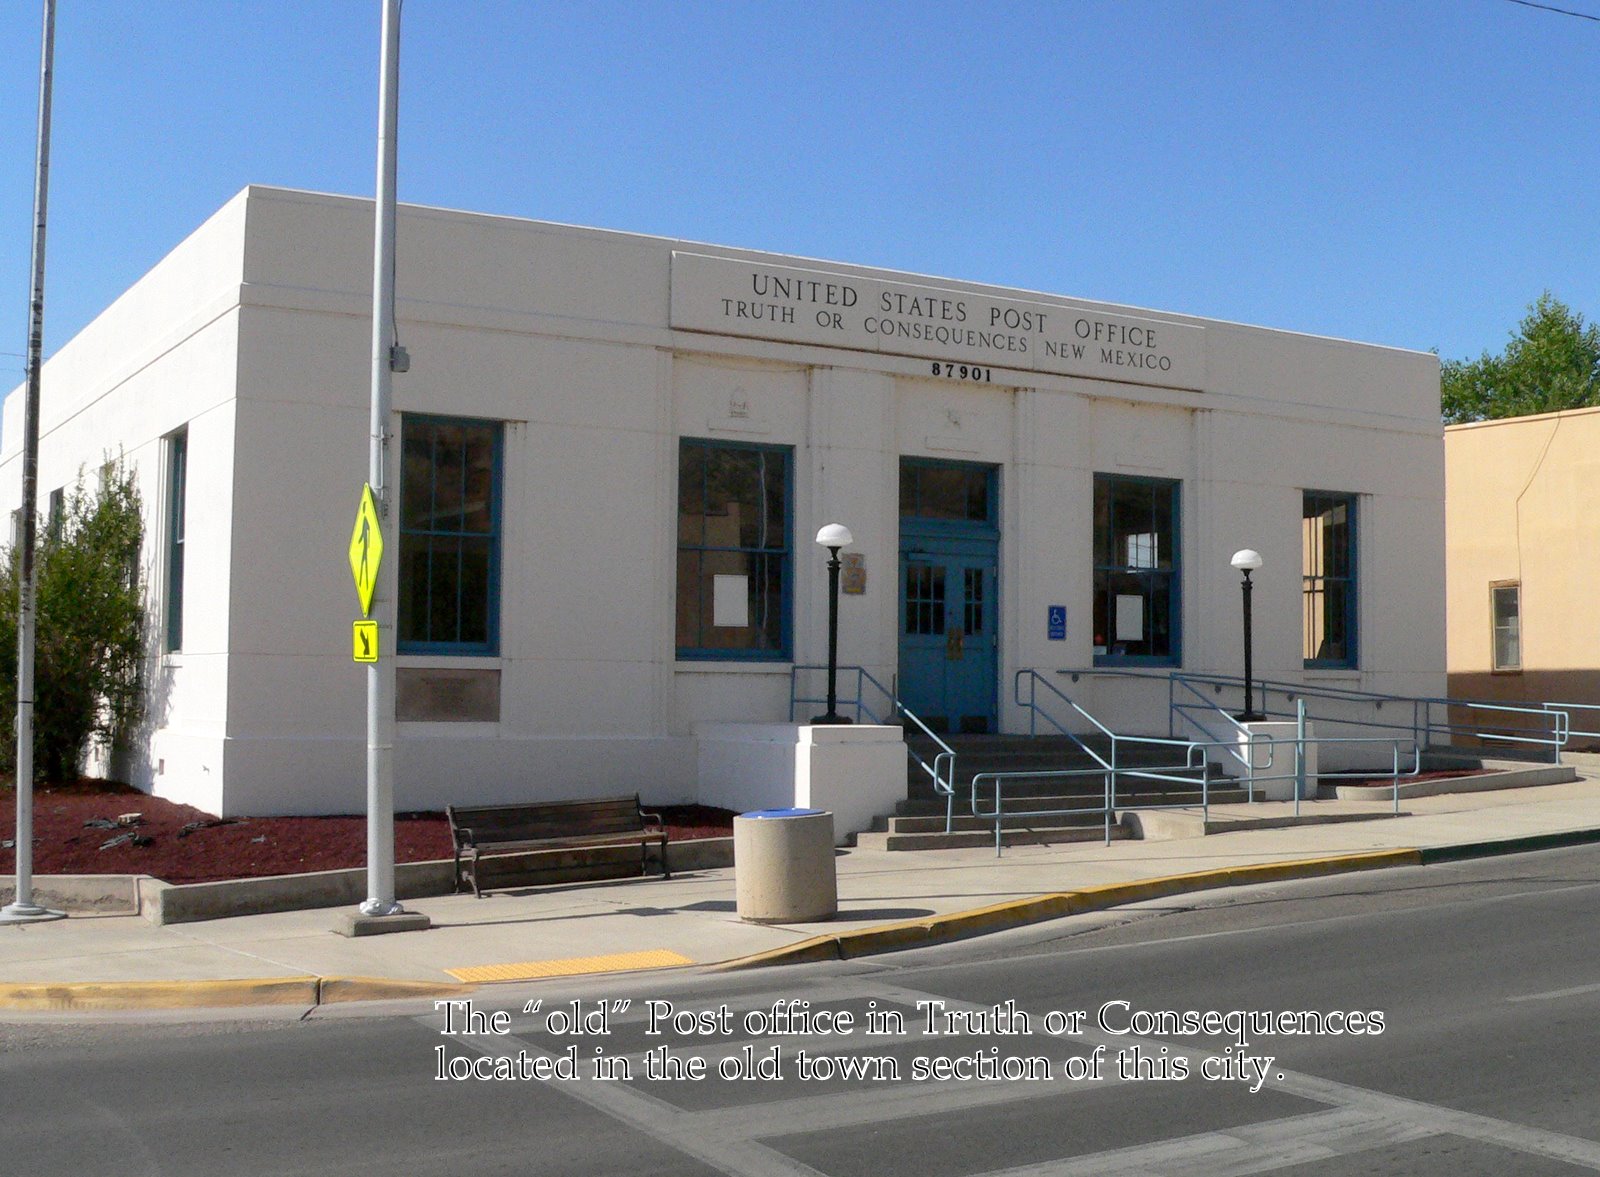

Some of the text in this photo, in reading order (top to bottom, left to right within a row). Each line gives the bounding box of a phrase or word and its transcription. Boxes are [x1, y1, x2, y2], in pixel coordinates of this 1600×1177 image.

[721, 298, 1171, 371] TRUTH OR CONSEQUENCES NEW MEXICO
[752, 273, 1157, 349] UNITED STATES POST OFFICE
[931, 362, 991, 382] 87901
